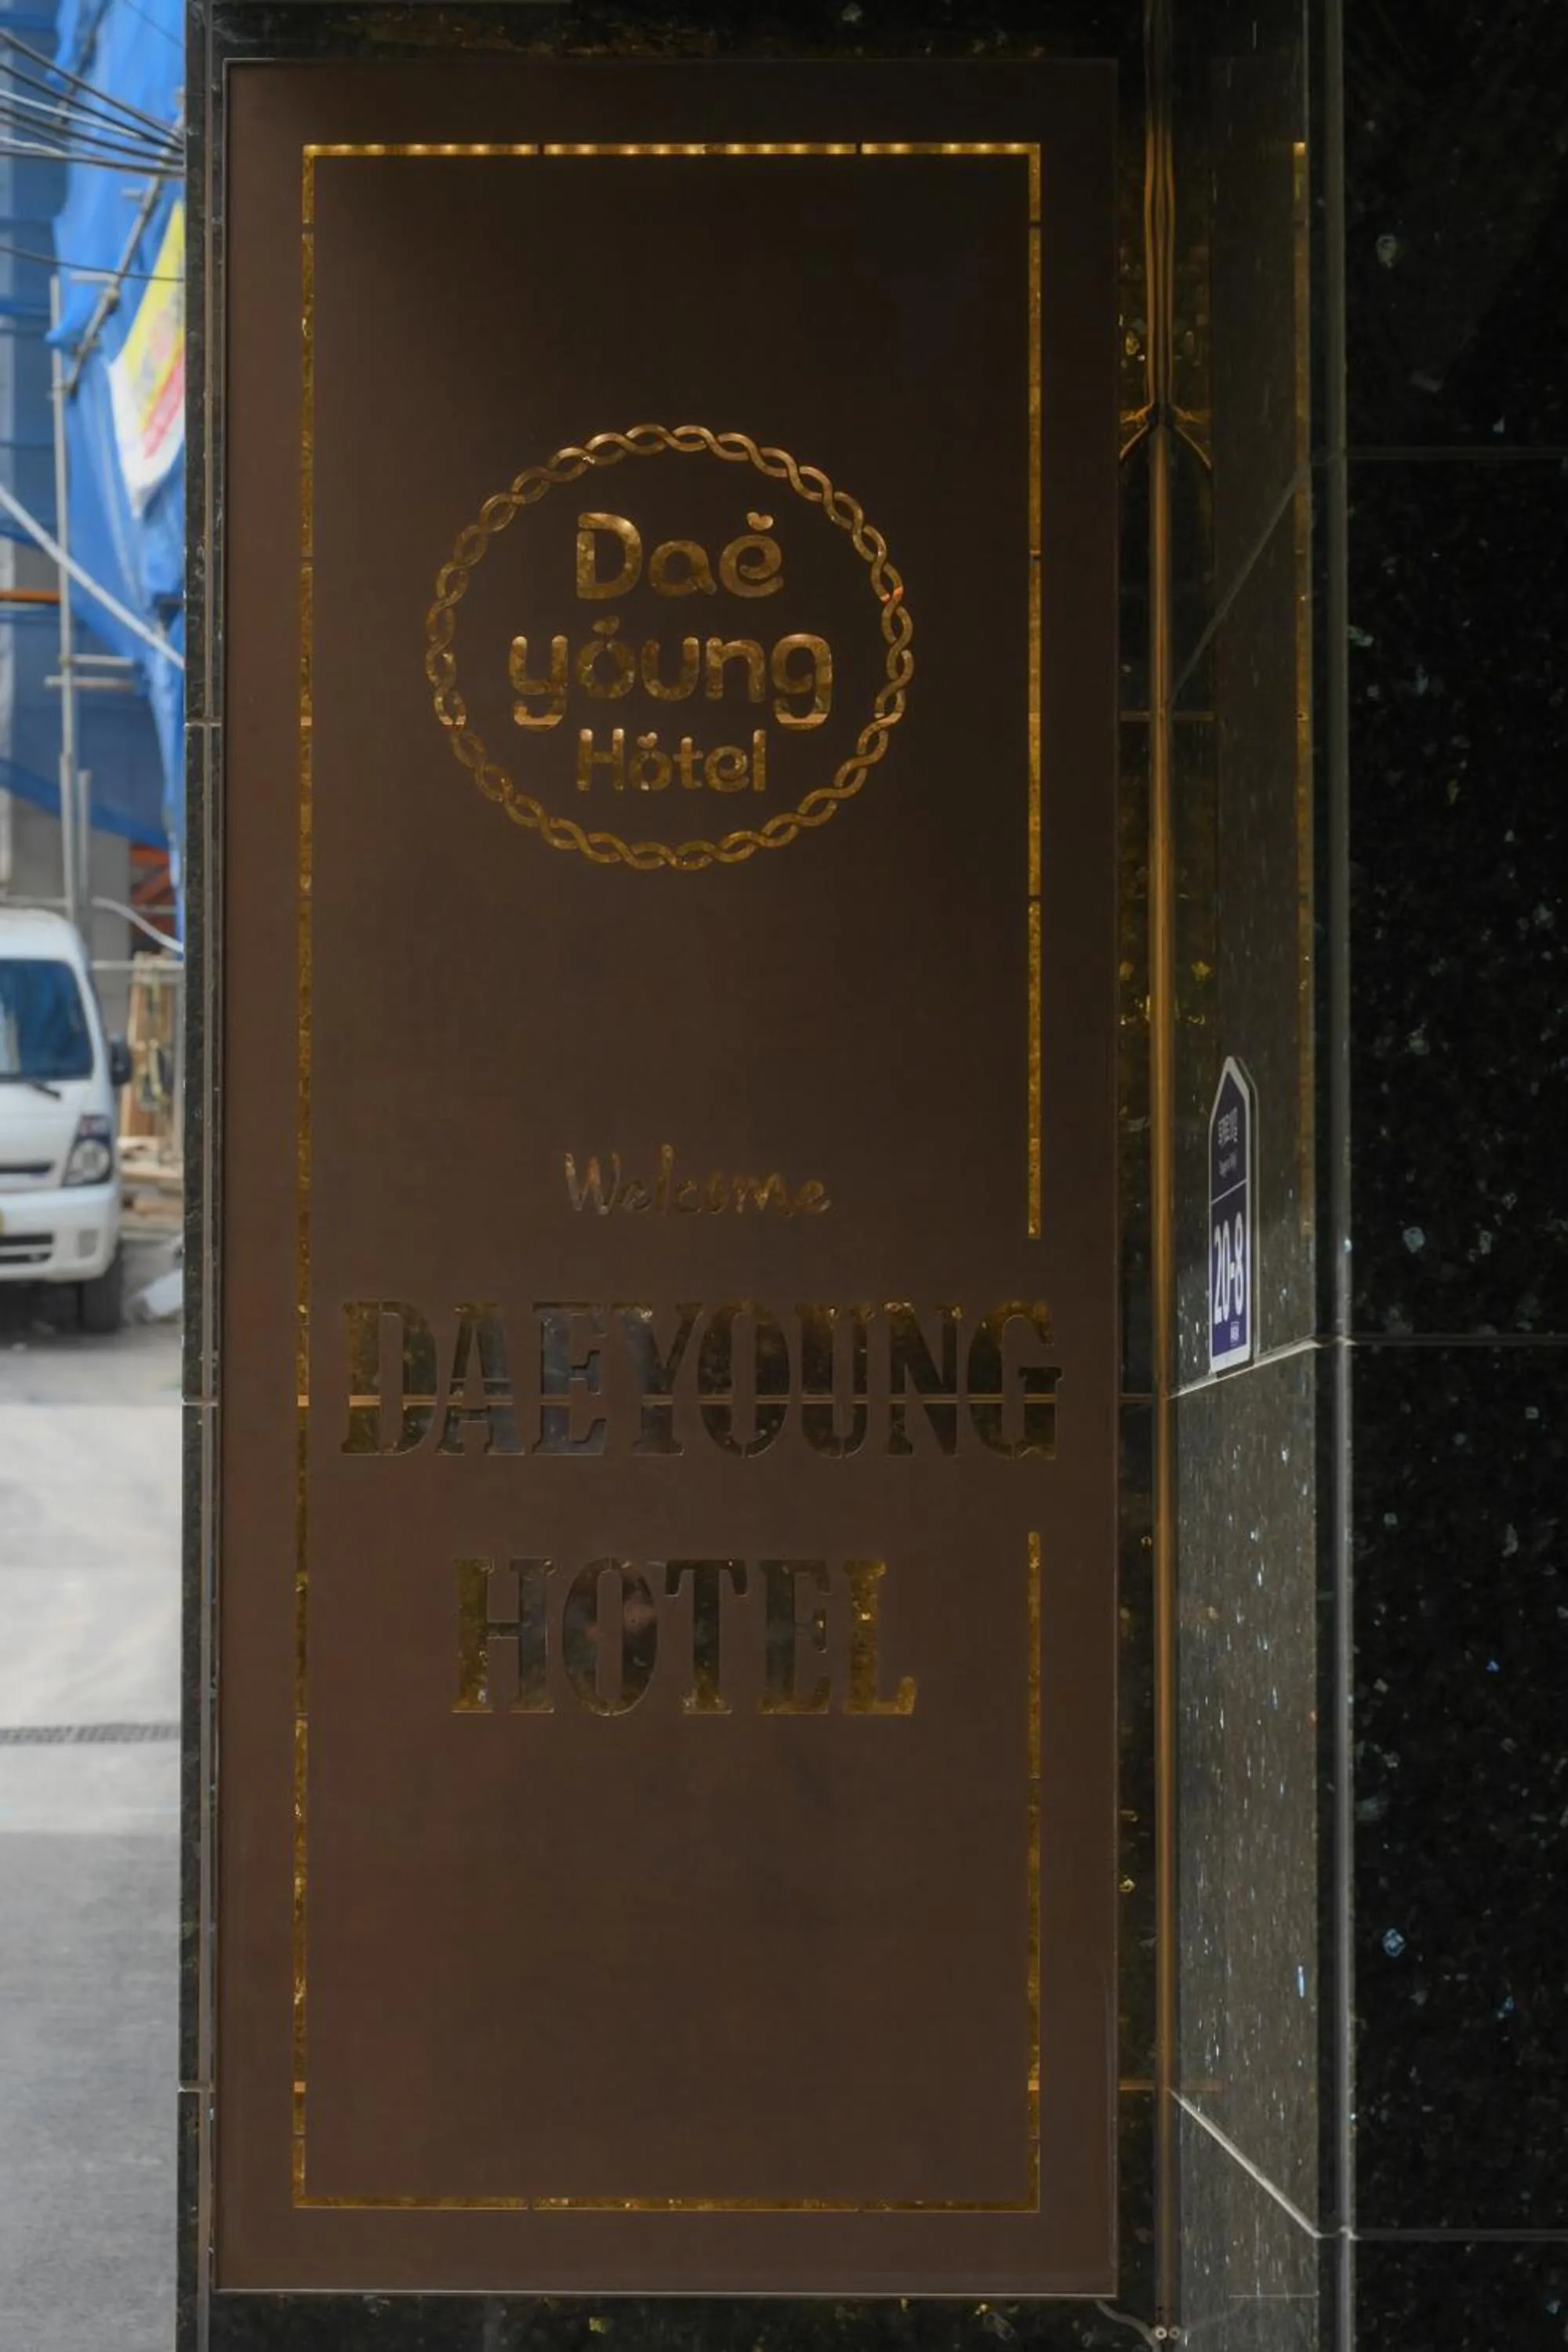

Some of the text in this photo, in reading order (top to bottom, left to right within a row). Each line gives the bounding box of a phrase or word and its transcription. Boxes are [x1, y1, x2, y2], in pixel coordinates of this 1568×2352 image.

[563, 1144, 833, 1217] Welcome
[1214, 1211, 1244, 1325] 20-8
[340, 1300, 1063, 1459] DAEYOUNG
[452, 1557, 918, 1716] HOTEL
